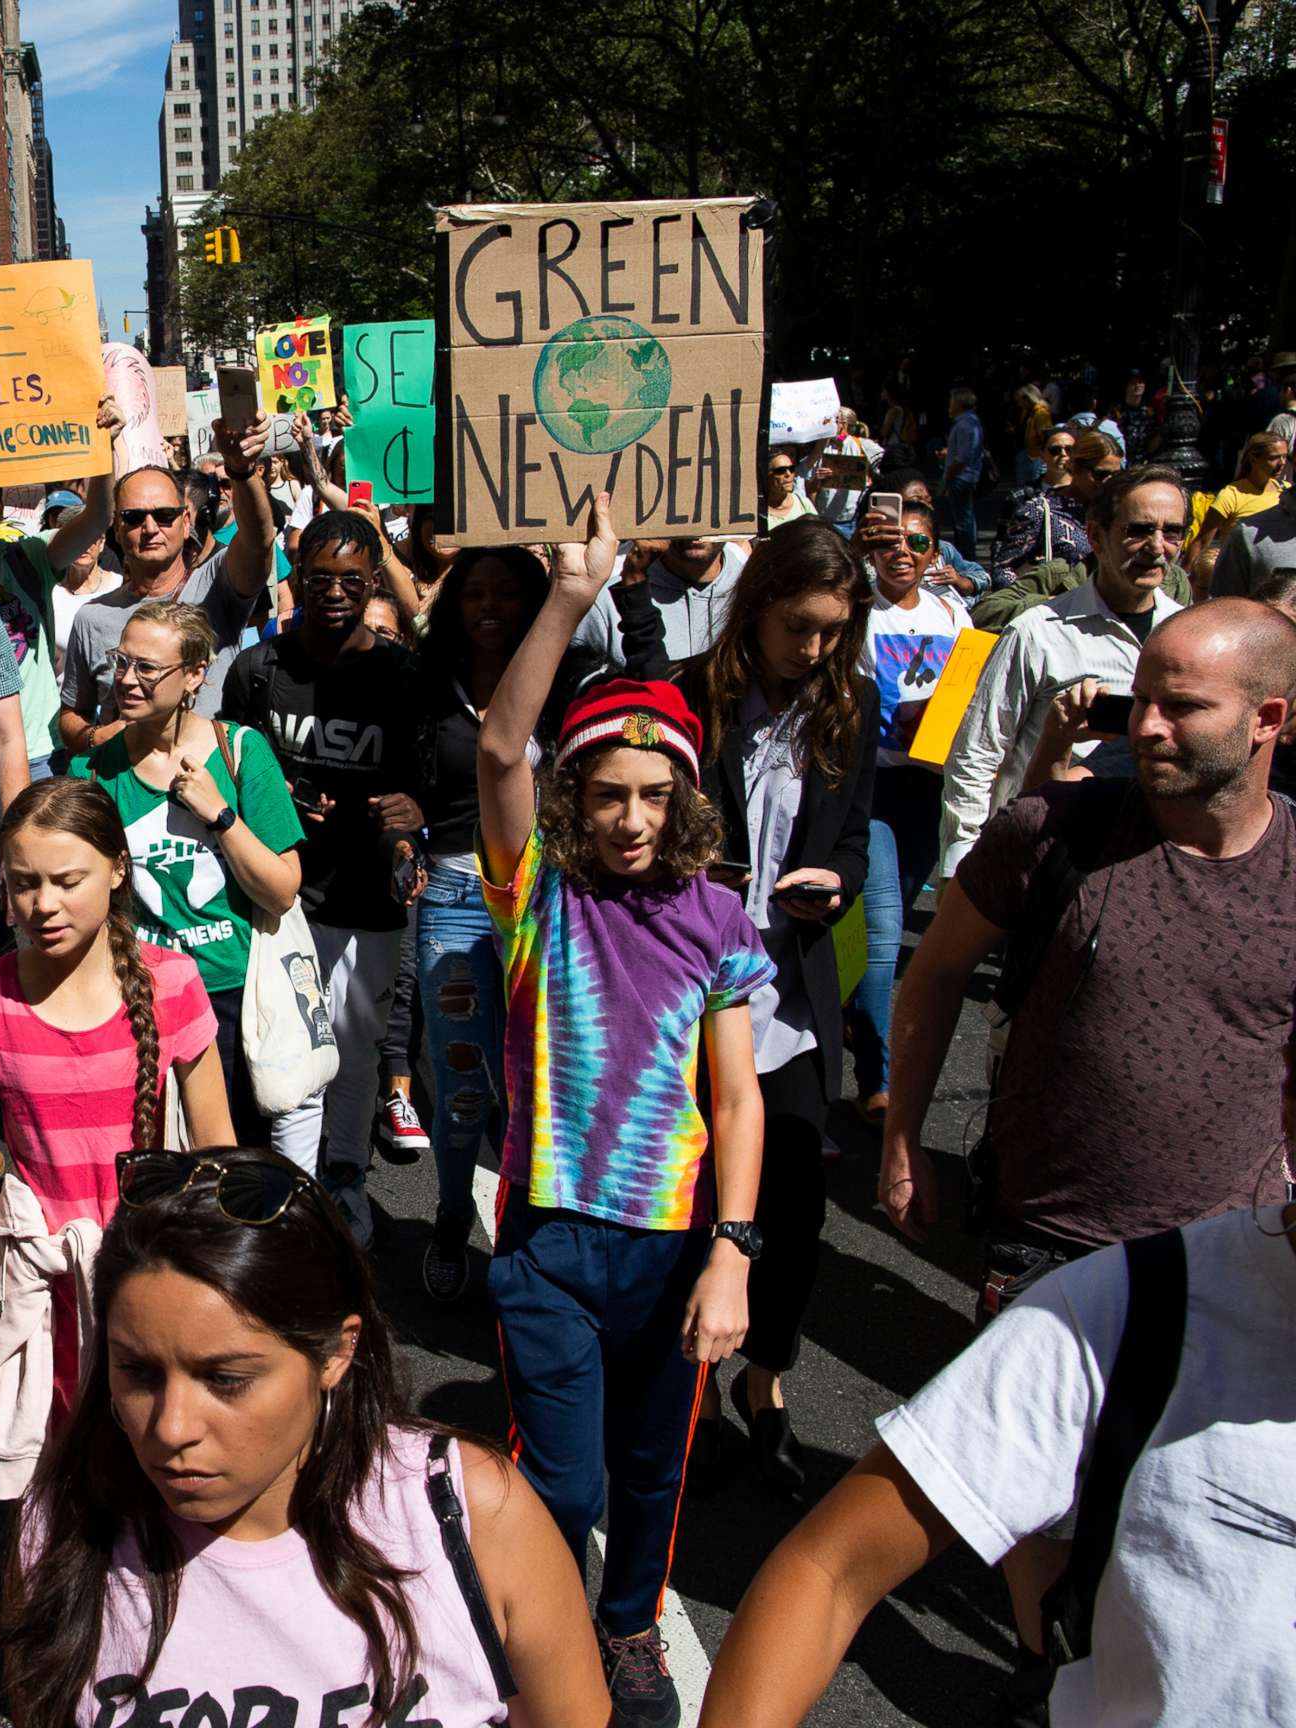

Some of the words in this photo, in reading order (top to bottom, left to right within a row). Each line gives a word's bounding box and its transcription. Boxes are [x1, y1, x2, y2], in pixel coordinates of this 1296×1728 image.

[455, 212, 750, 346] GREEN
[264, 330, 327, 360] LOVE
[272, 360, 321, 390] NOT
[455, 393, 624, 534] NEW
[635, 388, 756, 528] DEAL
[270, 709, 384, 764] NASA
